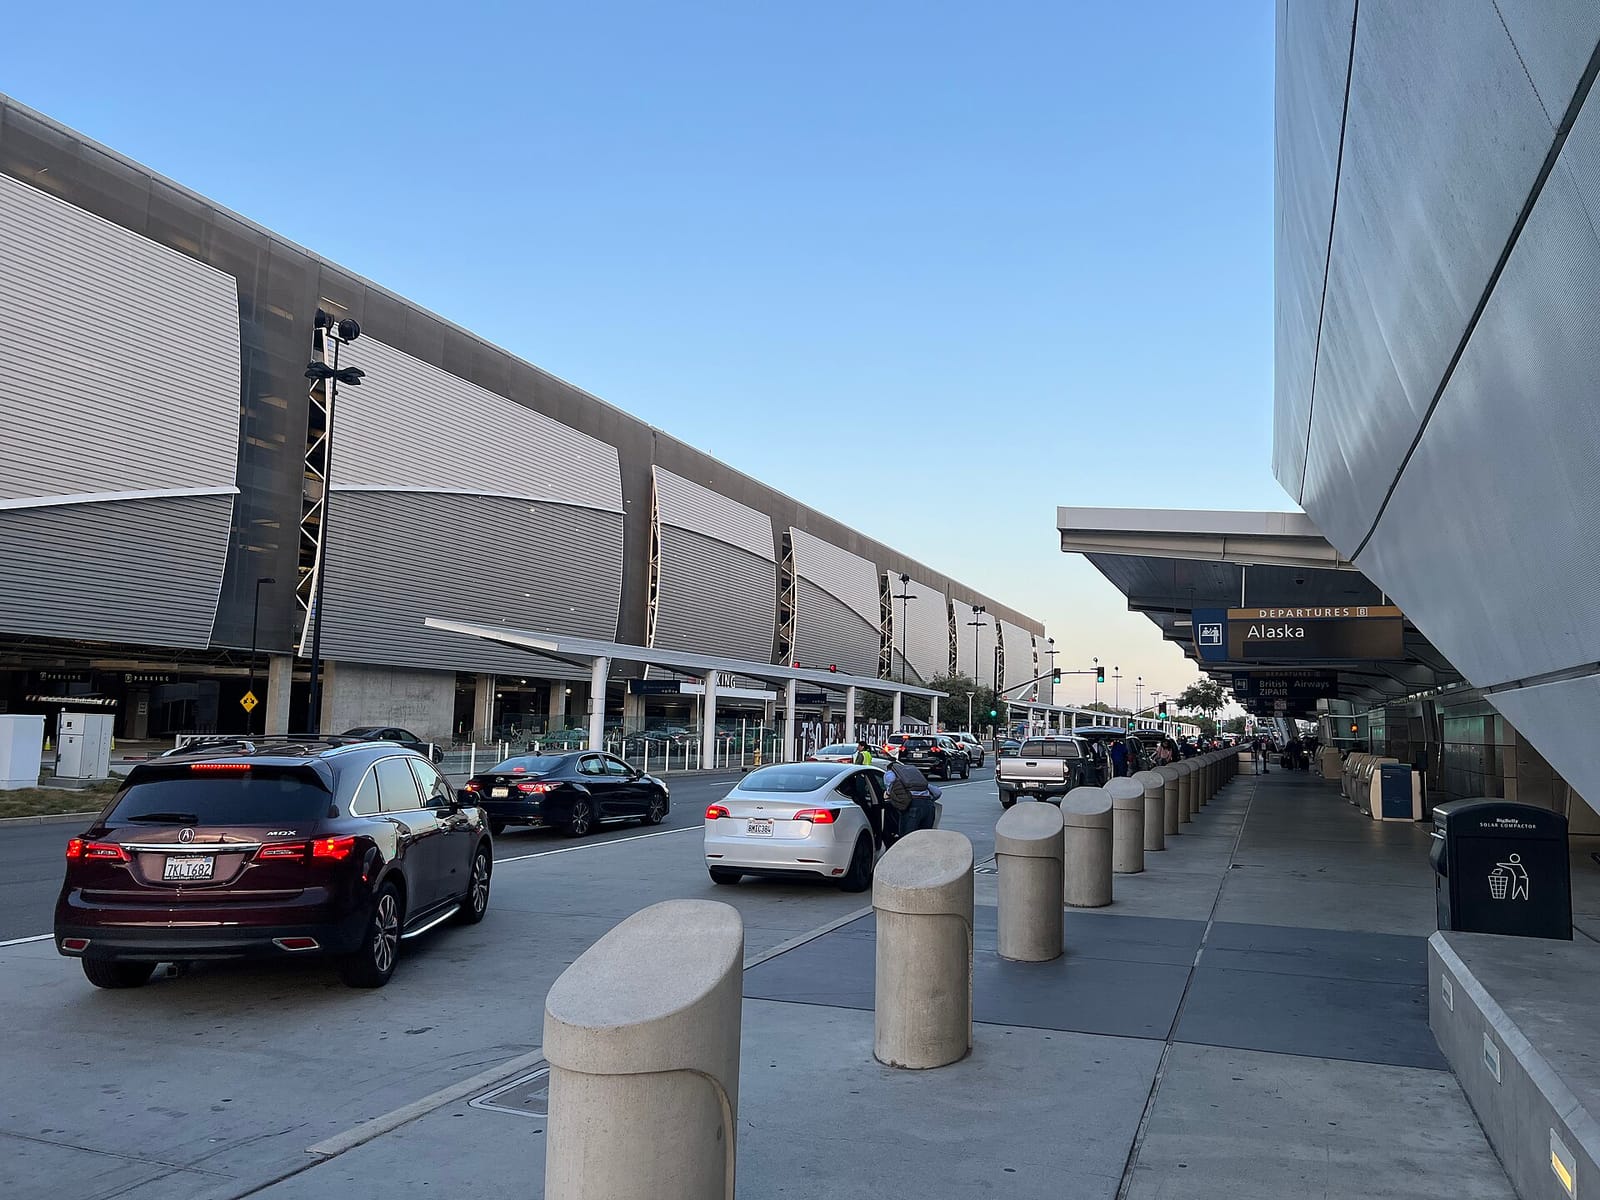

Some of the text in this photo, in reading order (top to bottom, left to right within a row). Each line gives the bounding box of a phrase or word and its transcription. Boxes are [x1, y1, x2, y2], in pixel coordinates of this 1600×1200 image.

[1259, 607, 1349, 618] DEPARTURES
[1247, 624, 1305, 639] Alaska
[134, 674, 169, 682] PARKING
[1259, 680, 1330, 689] British Airways
[1259, 688, 1288, 696] ZIPAIR
[167, 863, 211, 876] 7KLT682
